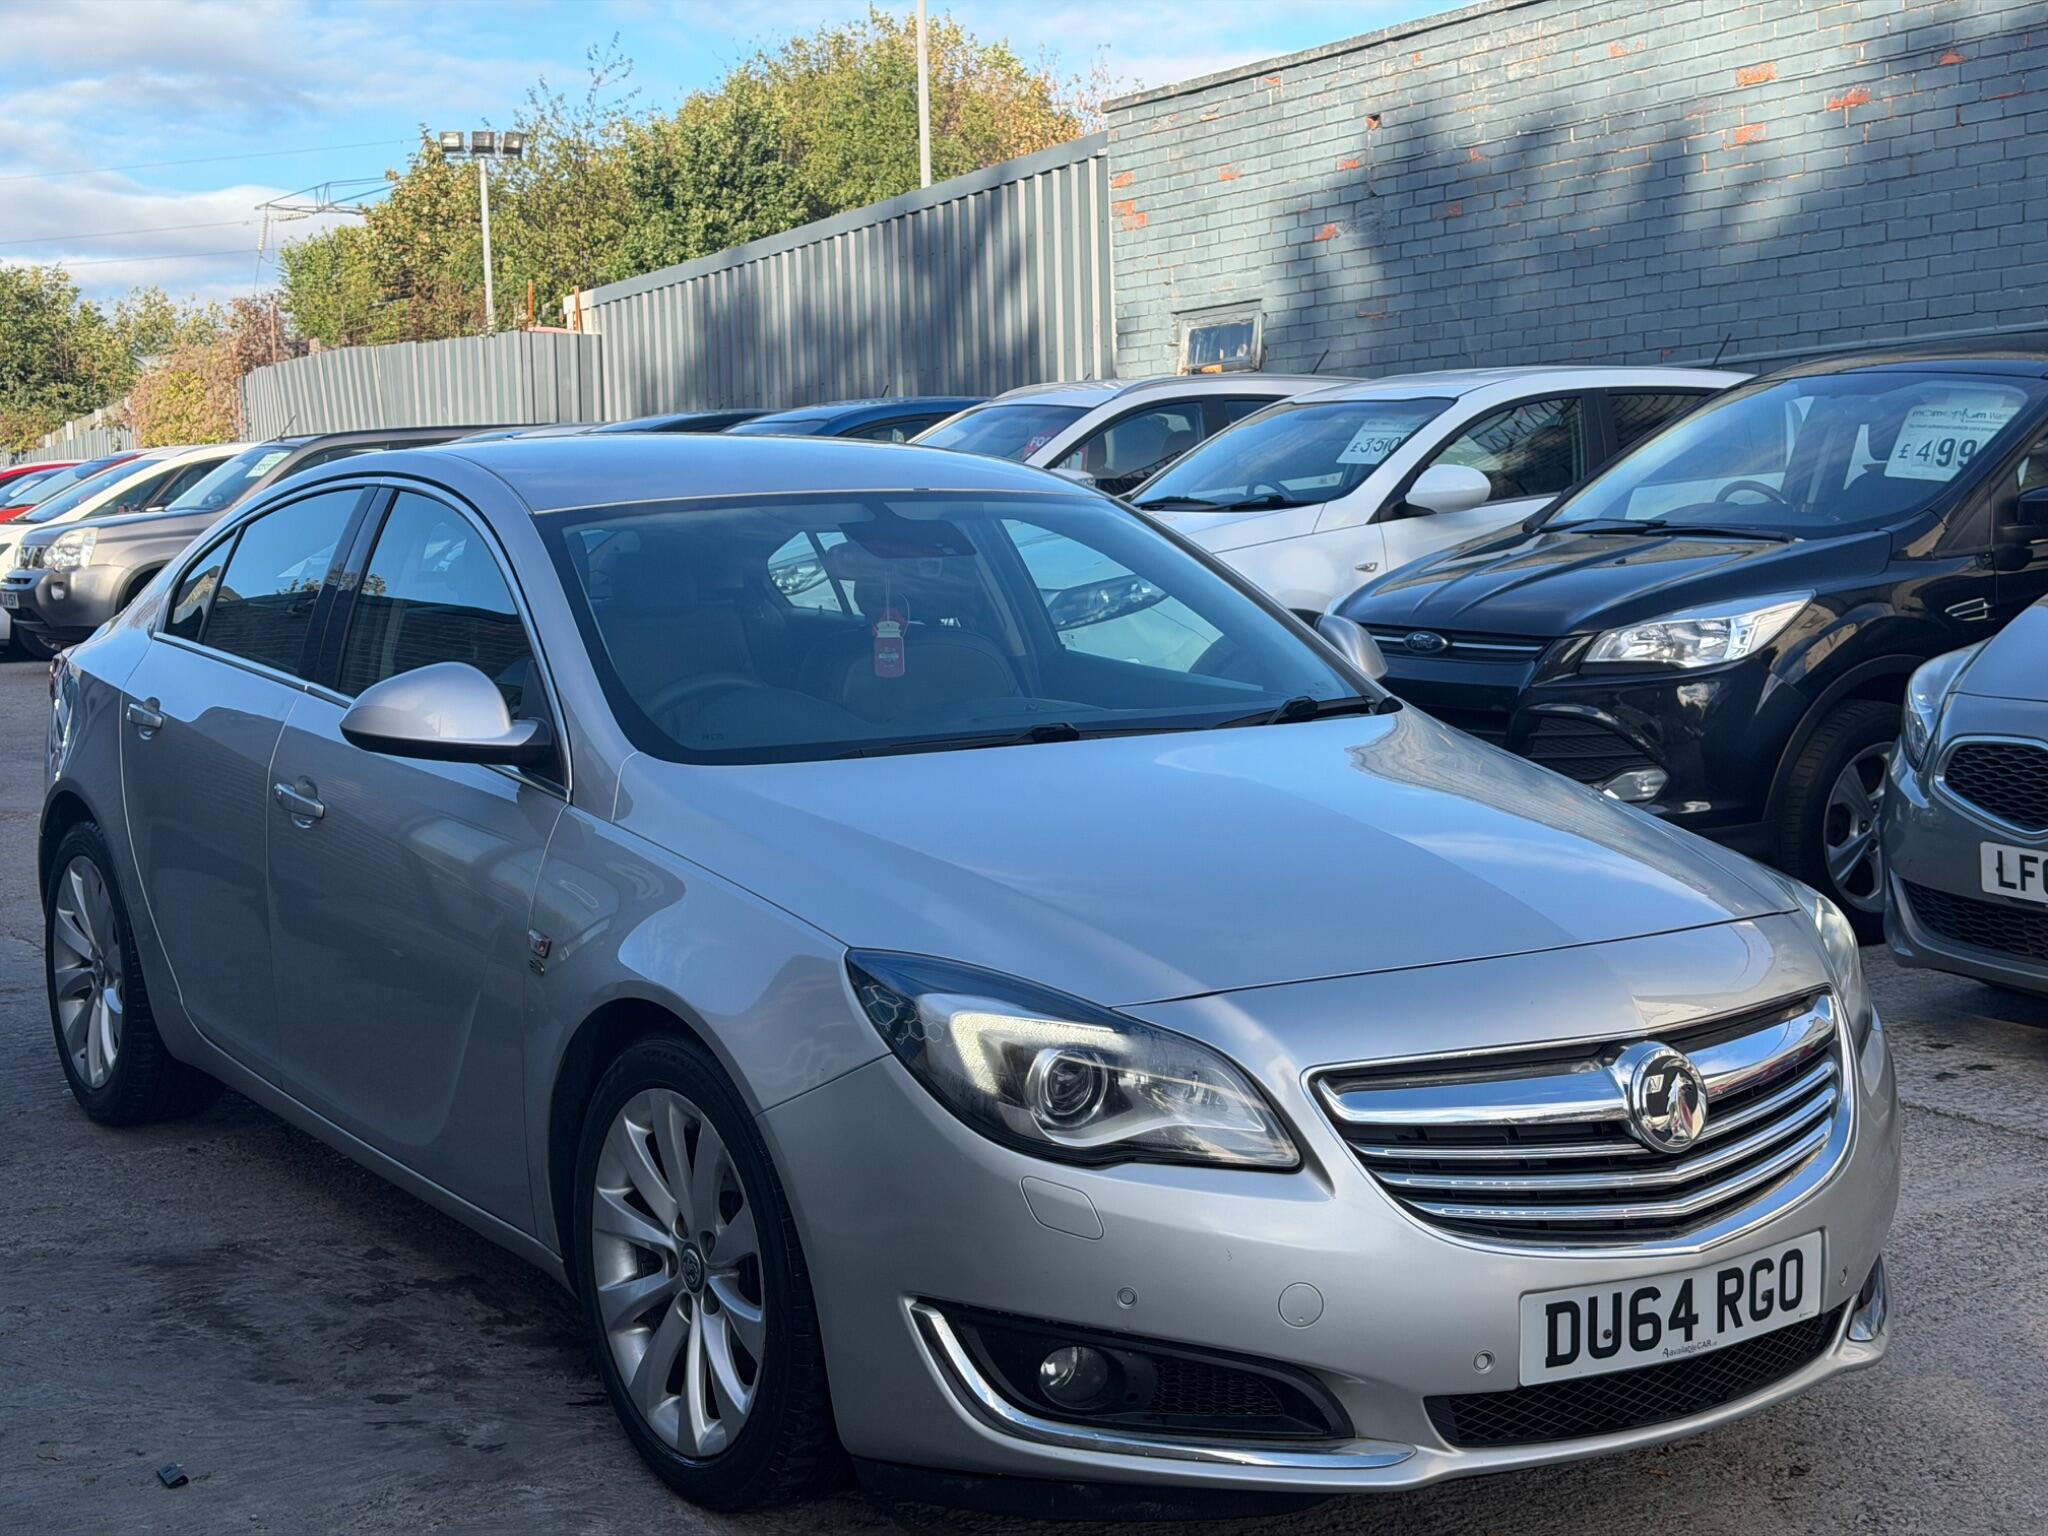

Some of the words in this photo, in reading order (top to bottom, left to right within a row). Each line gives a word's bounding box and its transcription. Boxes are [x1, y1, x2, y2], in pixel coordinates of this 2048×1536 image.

[1996, 850, 2048, 895] LF
[1545, 1278, 1698, 1368] DU64
[1717, 1248, 1803, 1334] RGO
